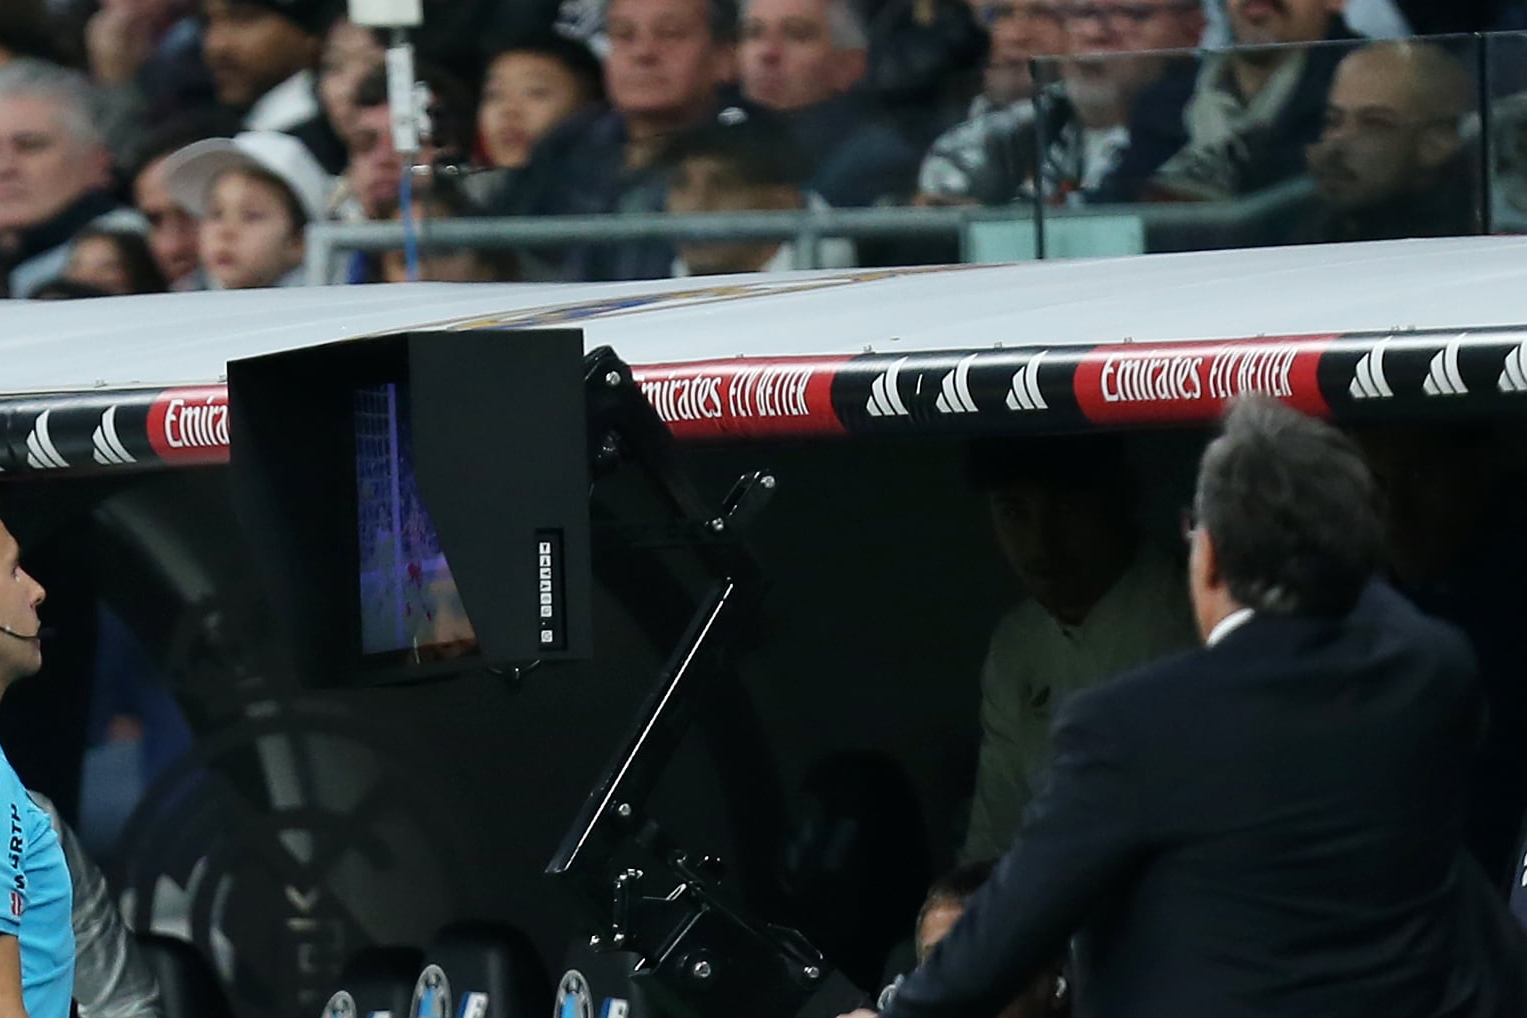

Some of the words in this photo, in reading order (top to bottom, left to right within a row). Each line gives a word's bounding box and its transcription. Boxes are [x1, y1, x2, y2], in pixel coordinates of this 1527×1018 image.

[633, 371, 722, 422] mirates
[729, 368, 759, 417] FLY
[756, 367, 815, 416] BETTER
[1101, 350, 1203, 402] Emirates
[1209, 348, 1241, 398] FLY
[165, 396, 230, 448] Emira
